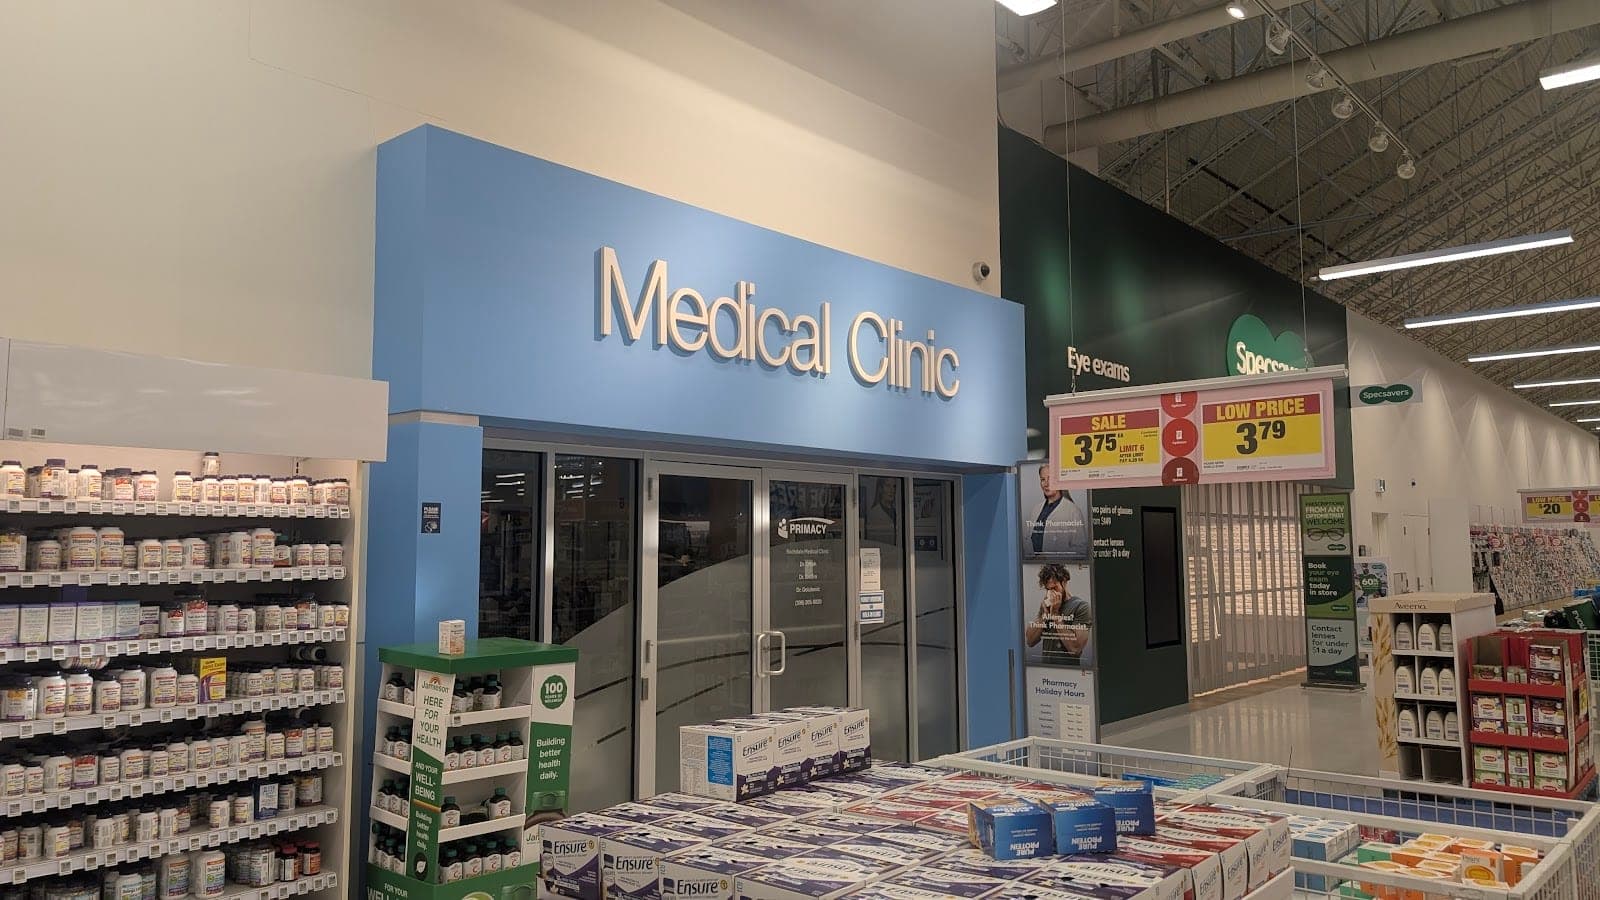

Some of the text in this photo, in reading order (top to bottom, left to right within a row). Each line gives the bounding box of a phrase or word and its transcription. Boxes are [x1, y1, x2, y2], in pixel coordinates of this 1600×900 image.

[599, 246, 960, 398] Medical Clinic
[1067, 346, 1130, 382] Eye exams
[1363, 389, 1409, 400] Specsavers
[1216, 397, 1305, 421] LOW PRICE
[1091, 413, 1127, 431] SALE
[1119, 444, 1145, 453] LIMIT 6
[1100, 507, 1111, 515] pairs
[1305, 505, 1345, 514] FROM ANY
[1539, 503, 1561, 515] $20
[789, 523, 827, 535] PRIMACY
[1093, 538, 1110, 547] ontact
[1122, 549, 1130, 559] day
[1309, 582, 1331, 590] today
[1042, 613, 1075, 622] Allergies?
[1030, 621, 1048, 629] Think
[1312, 625, 1343, 633] Contact
[1312, 632, 1336, 640] lenses
[1325, 640, 1350, 648] under
[421, 680, 449, 694] Jamieson
[544, 681, 564, 694] 100
[1042, 678, 1077, 689] Pharmacy
[1035, 687, 1086, 698] Holiday Hours
[423, 695, 444, 708] HERE
[424, 708, 439, 721] FOR
[420, 720, 440, 735] YOUR
[843, 719, 865, 735] Ensure
[811, 725, 834, 742] Ensure
[416, 731, 442, 749] HEALTH
[536, 737, 566, 748] Building
[777, 731, 801, 749] Ensure
[540, 748, 562, 758] better
[742, 739, 768, 757] Ensure
[415, 761, 438, 775] AND YOUR
[538, 759, 561, 769] health
[415, 771, 436, 787] WELL-
[539, 770, 559, 780] daily.
[414, 785, 436, 801] BEING
[415, 810, 433, 825] Building
[1116, 819, 1140, 827] PROTE
[416, 821, 430, 831] better
[416, 830, 430, 841] health
[1071, 836, 1103, 845] PROTEIN
[554, 841, 588, 856] Ensure
[1010, 841, 1040, 850] PROTEIN
[1078, 843, 1098, 851] PURE
[1016, 849, 1035, 857] PURE
[615, 856, 654, 872] Ensure
[384, 882, 408, 898] FOR YOUR
[677, 879, 719, 896] Ensure
